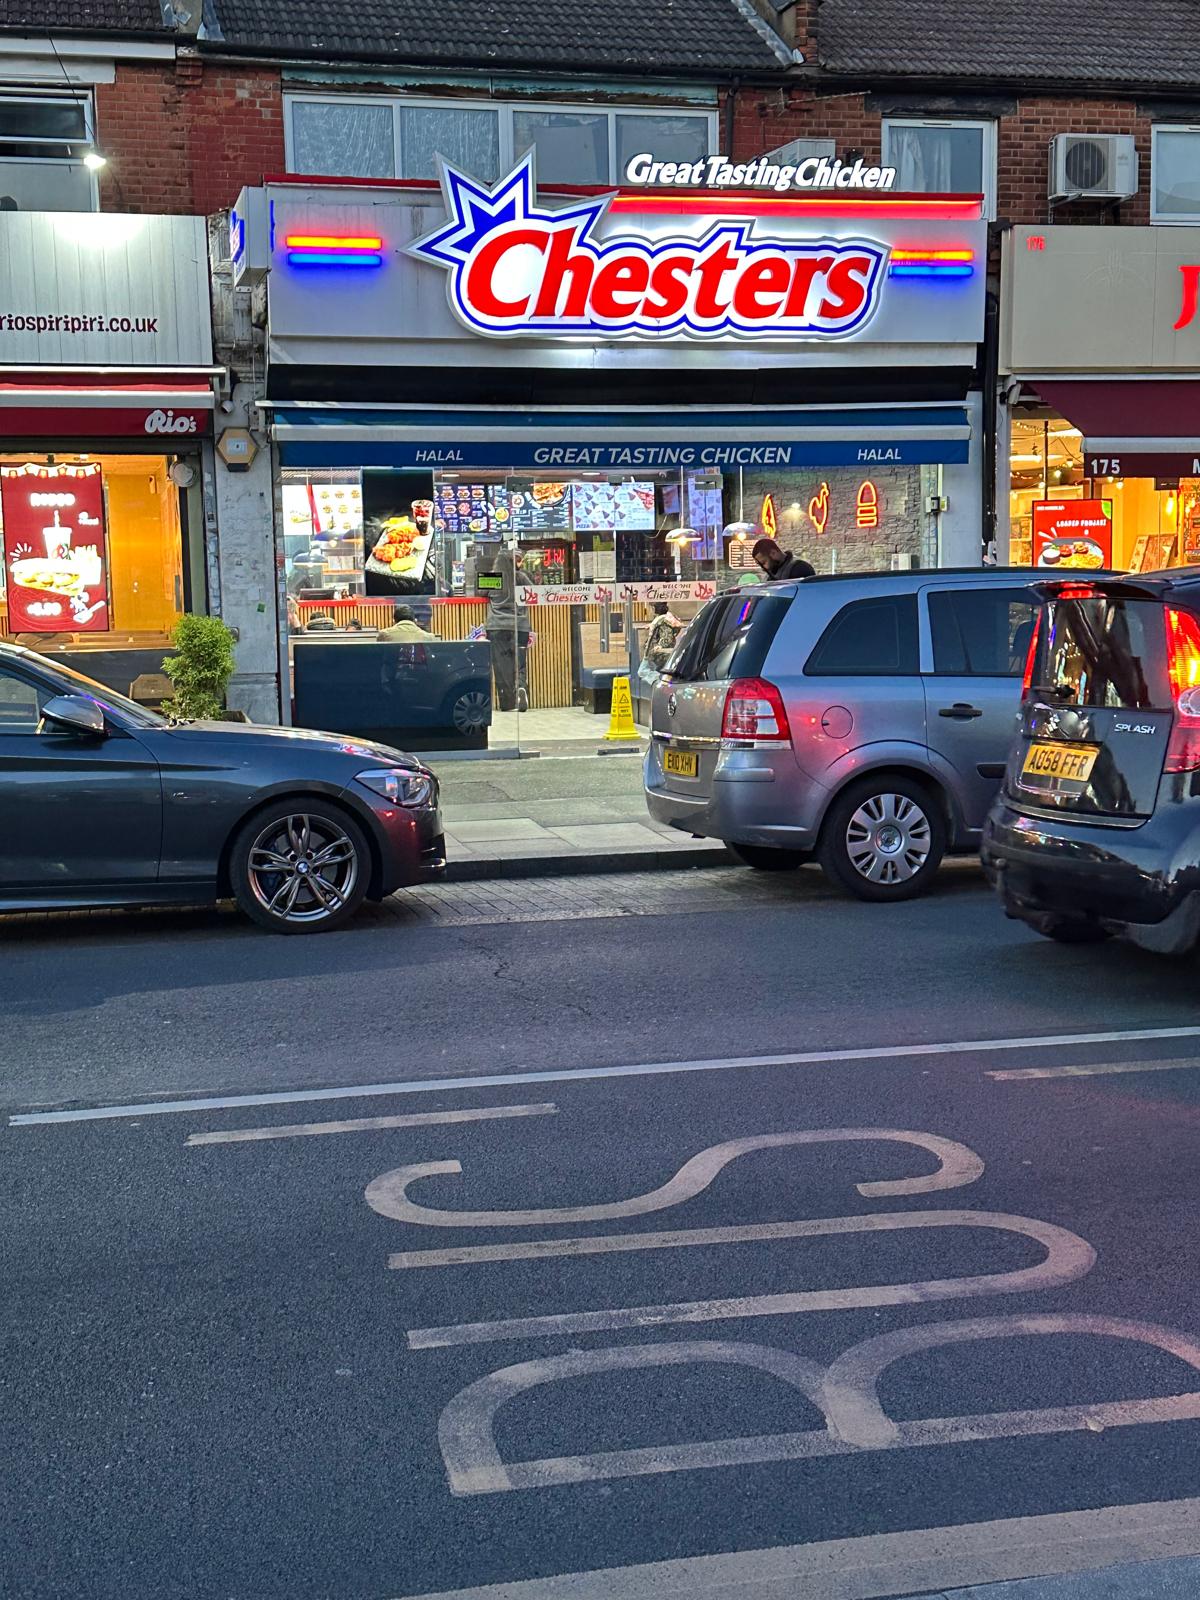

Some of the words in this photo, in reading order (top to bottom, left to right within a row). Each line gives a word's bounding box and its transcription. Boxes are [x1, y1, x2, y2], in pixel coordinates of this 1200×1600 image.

[626, 153, 705, 184] Great
[706, 155, 797, 191] Tasting
[795, 157, 897, 188] Chicken
[467, 227, 872, 320] Chesters
[0, 313, 158, 334] riospiripiri.co.uk
[145, 409, 197, 433] Rio's
[415, 449, 464, 462] HALAL
[534, 447, 604, 464] GREAT
[607, 447, 695, 464] TASTING
[700, 447, 791, 464] CHICKEN
[857, 448, 902, 460] HALAL
[1091, 459, 1121, 474] 175
[1114, 723, 1156, 735] SPLASH
[1060, 753, 1089, 776] FFR
[364, 1127, 1200, 1497] BUS
